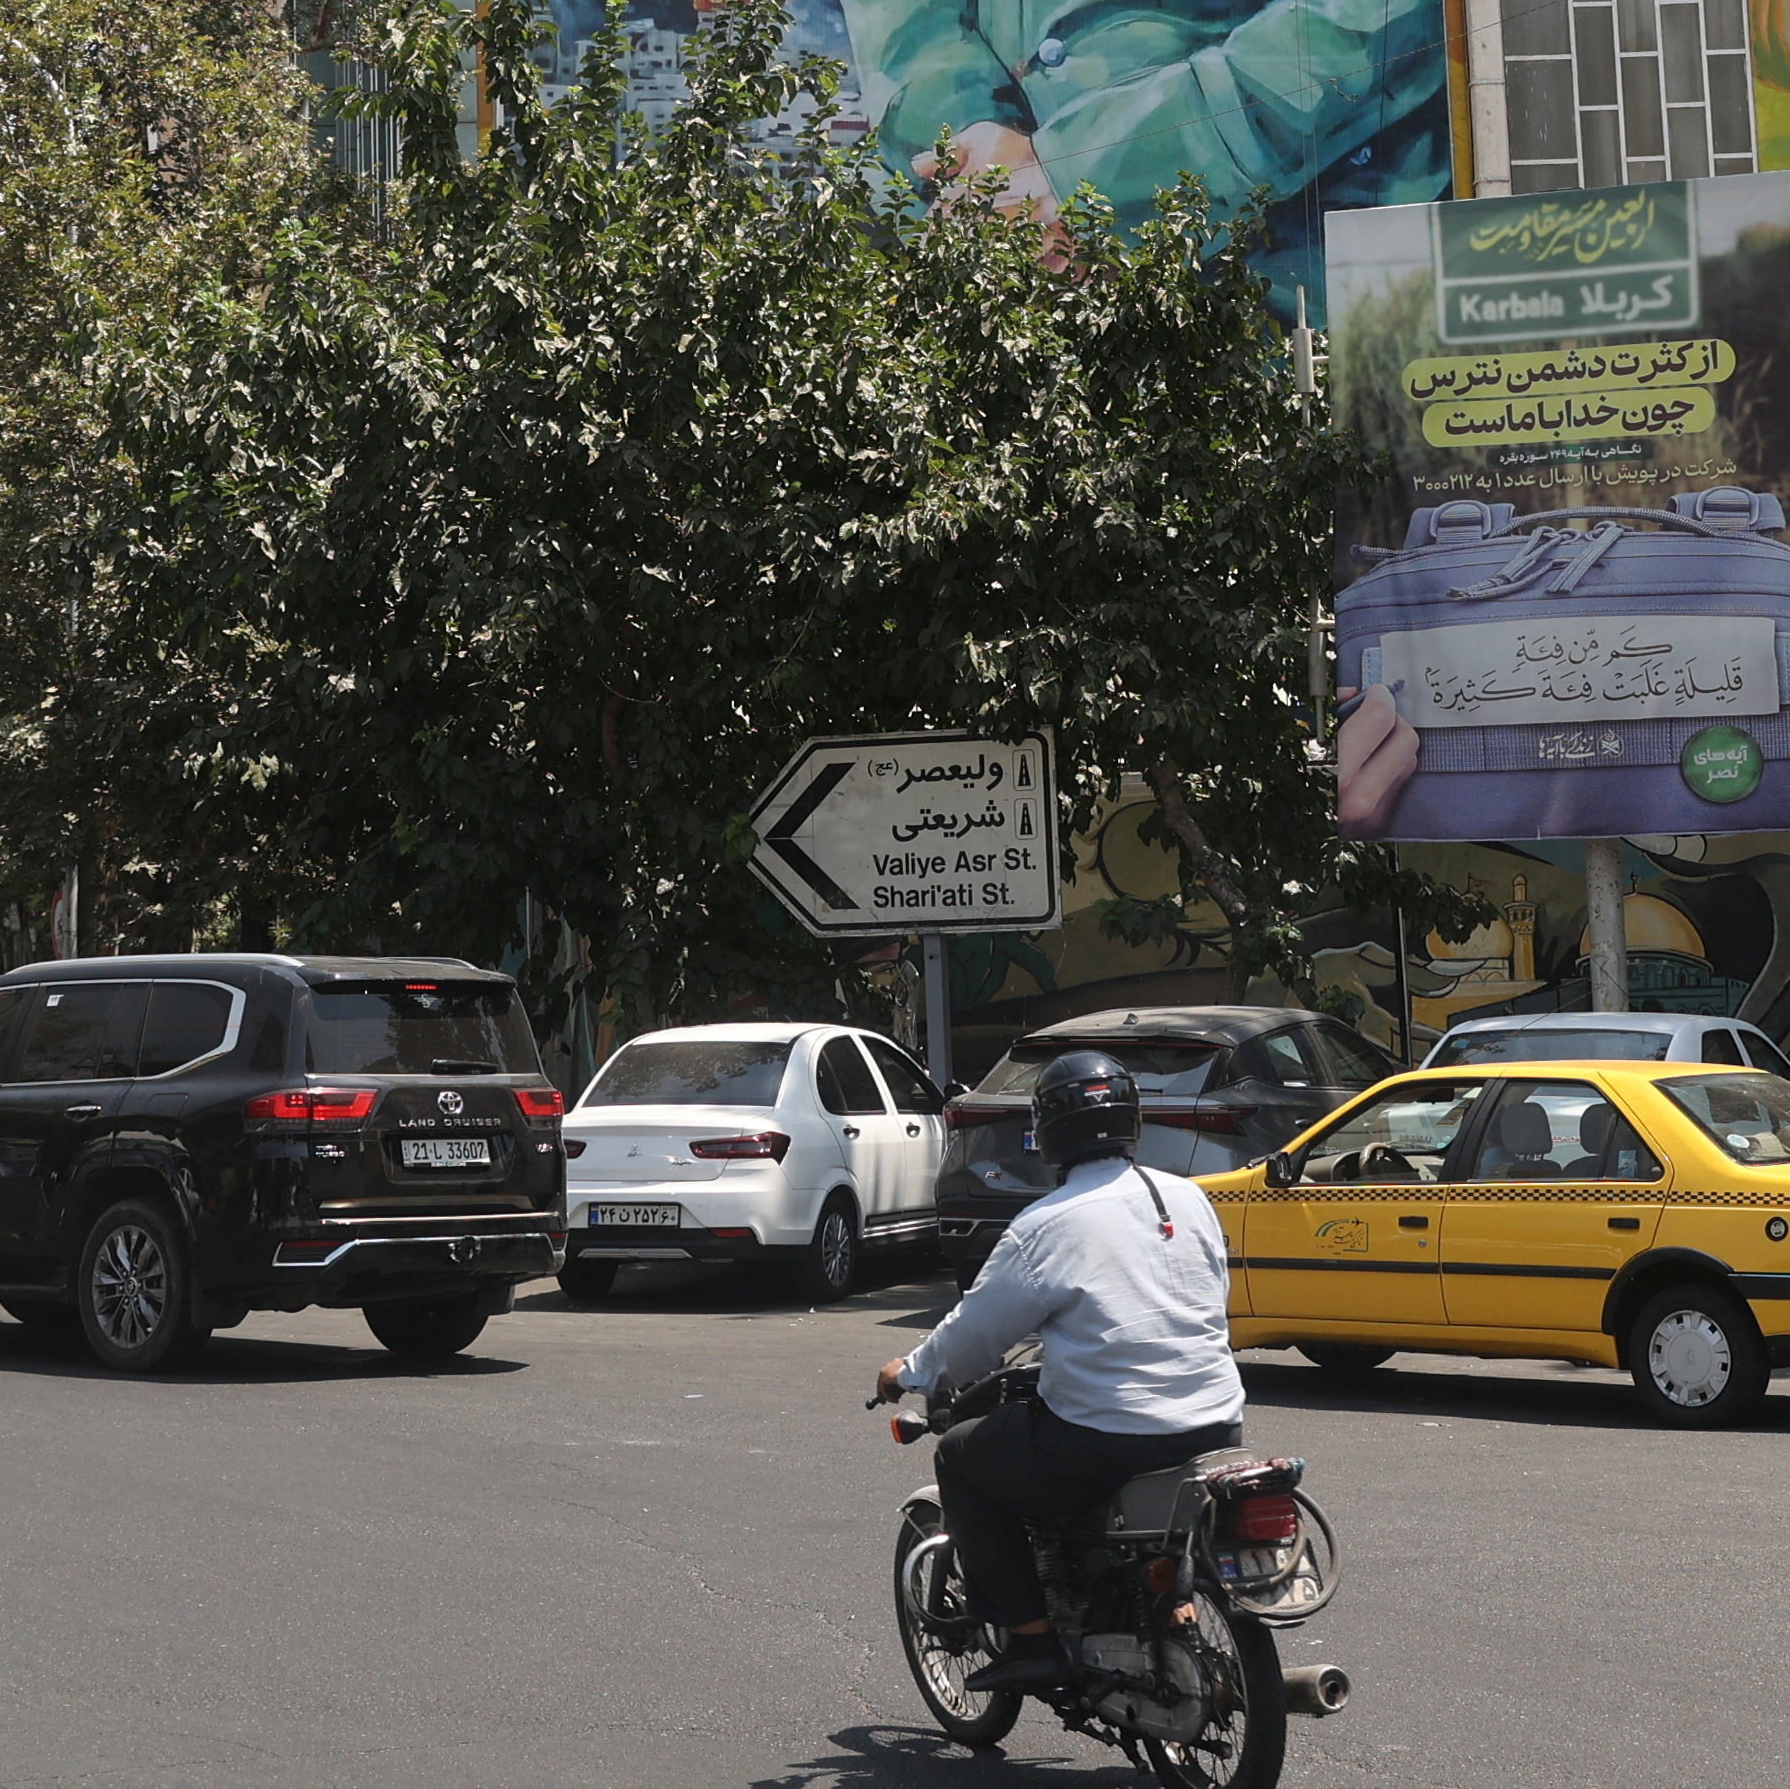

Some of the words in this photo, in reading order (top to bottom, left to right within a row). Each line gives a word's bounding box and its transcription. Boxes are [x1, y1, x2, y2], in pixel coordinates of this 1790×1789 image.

[1580, 274, 1673, 322] کربلا
[1507, 349, 1607, 393] دشمن
[1611, 341, 1694, 384] کثرت
[1690, 340, 1718, 380] از
[1410, 358, 1502, 399] نترس
[1566, 395, 1620, 429] خدا
[1621, 397, 1695, 436] چون
[1503, 473, 1536, 488] عدد
[1539, 466, 1588, 488] ارسال
[1592, 465, 1602, 485] با
[1605, 464, 1658, 486] پویش
[1659, 467, 1681, 483] در
[1685, 457, 1737, 480] شرکت
[1475, 477, 1492, 493] به
[896, 754, 1004, 793] ولیعصر
[1707, 766, 1739, 784] نصر
[892, 800, 1005, 843] شریعتی
[872, 853, 946, 879] Valiye
[954, 852, 997, 873] Asr
[1004, 848, 1037, 871] St.
[872, 883, 973, 909] Shari'ati
[982, 882, 1015, 906] St.
[399, 1119, 435, 1127] LAND
[444, 1118, 501, 1127] CRUISER
[413, 1142, 429, 1160] 21
[447, 1141, 484, 1159] 33607
[985, 1171, 1002, 1180] FX
